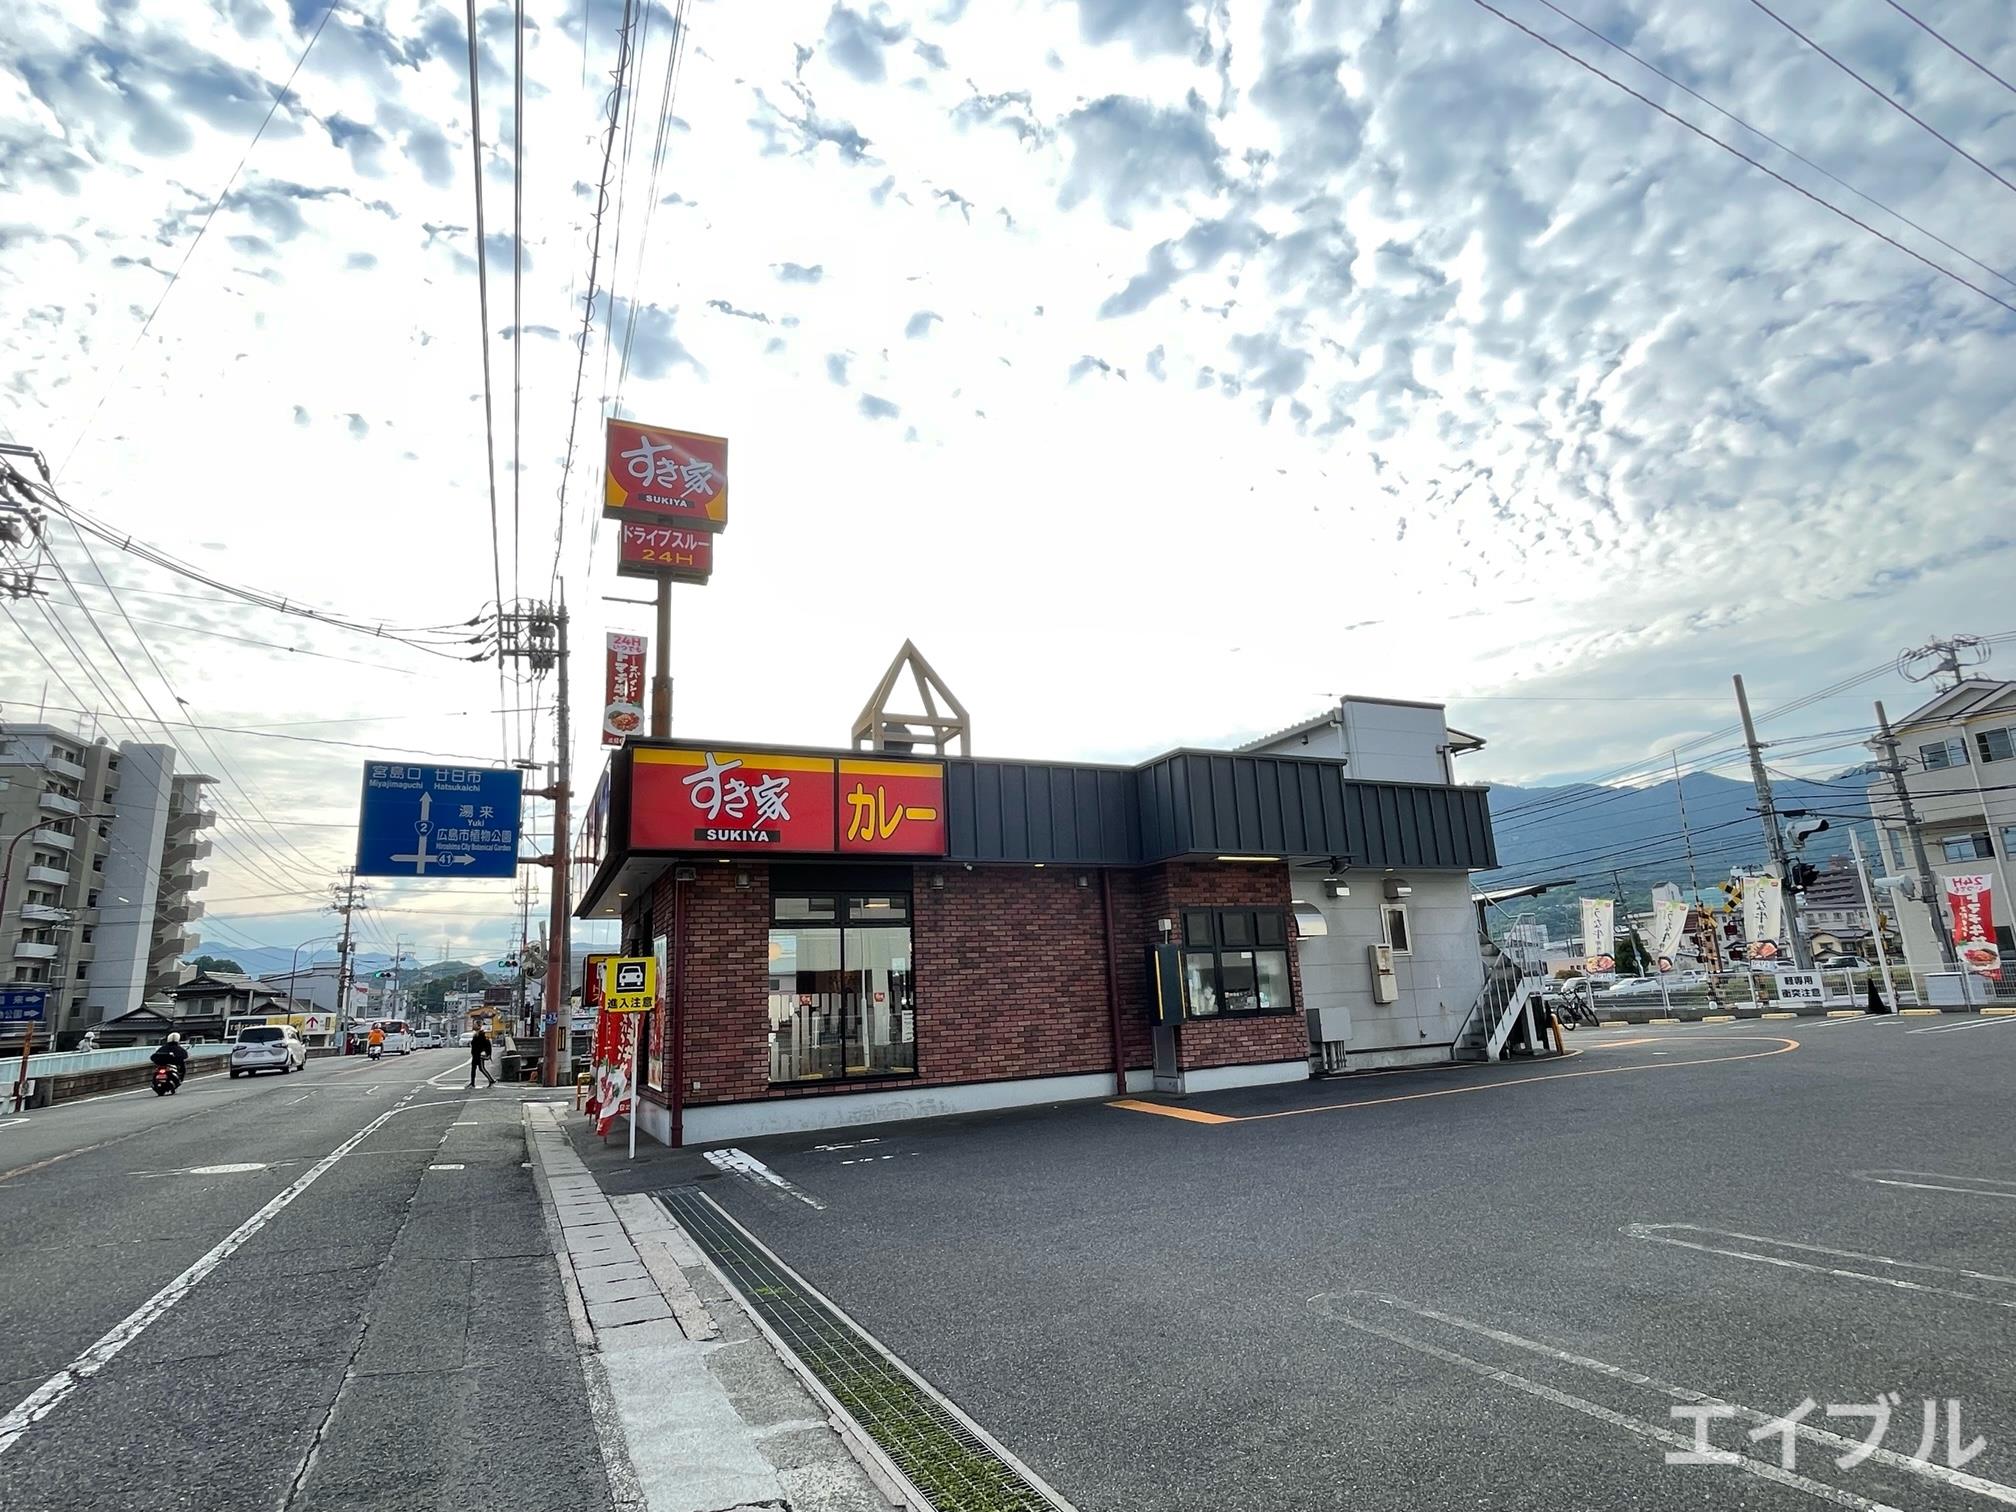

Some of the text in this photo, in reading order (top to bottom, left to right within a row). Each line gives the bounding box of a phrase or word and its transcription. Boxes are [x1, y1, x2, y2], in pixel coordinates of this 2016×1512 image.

[621, 435, 713, 497] すき家
[645, 495, 688, 507] SUKIYA
[623, 525, 710, 550] ドライブスルー
[642, 549, 693, 565] 24H
[613, 634, 641, 646] 24H
[372, 765, 482, 783] 宮島口 廿日市
[434, 783, 481, 792] Hatsukaichi
[682, 751, 791, 829] すき家
[847, 783, 937, 841] カレー
[420, 823, 428, 833] 2
[467, 819, 485, 827] Yuki
[706, 829, 769, 843] SUKIYA
[438, 854, 452, 864] 41
[607, 996, 653, 1009] 進入注意
